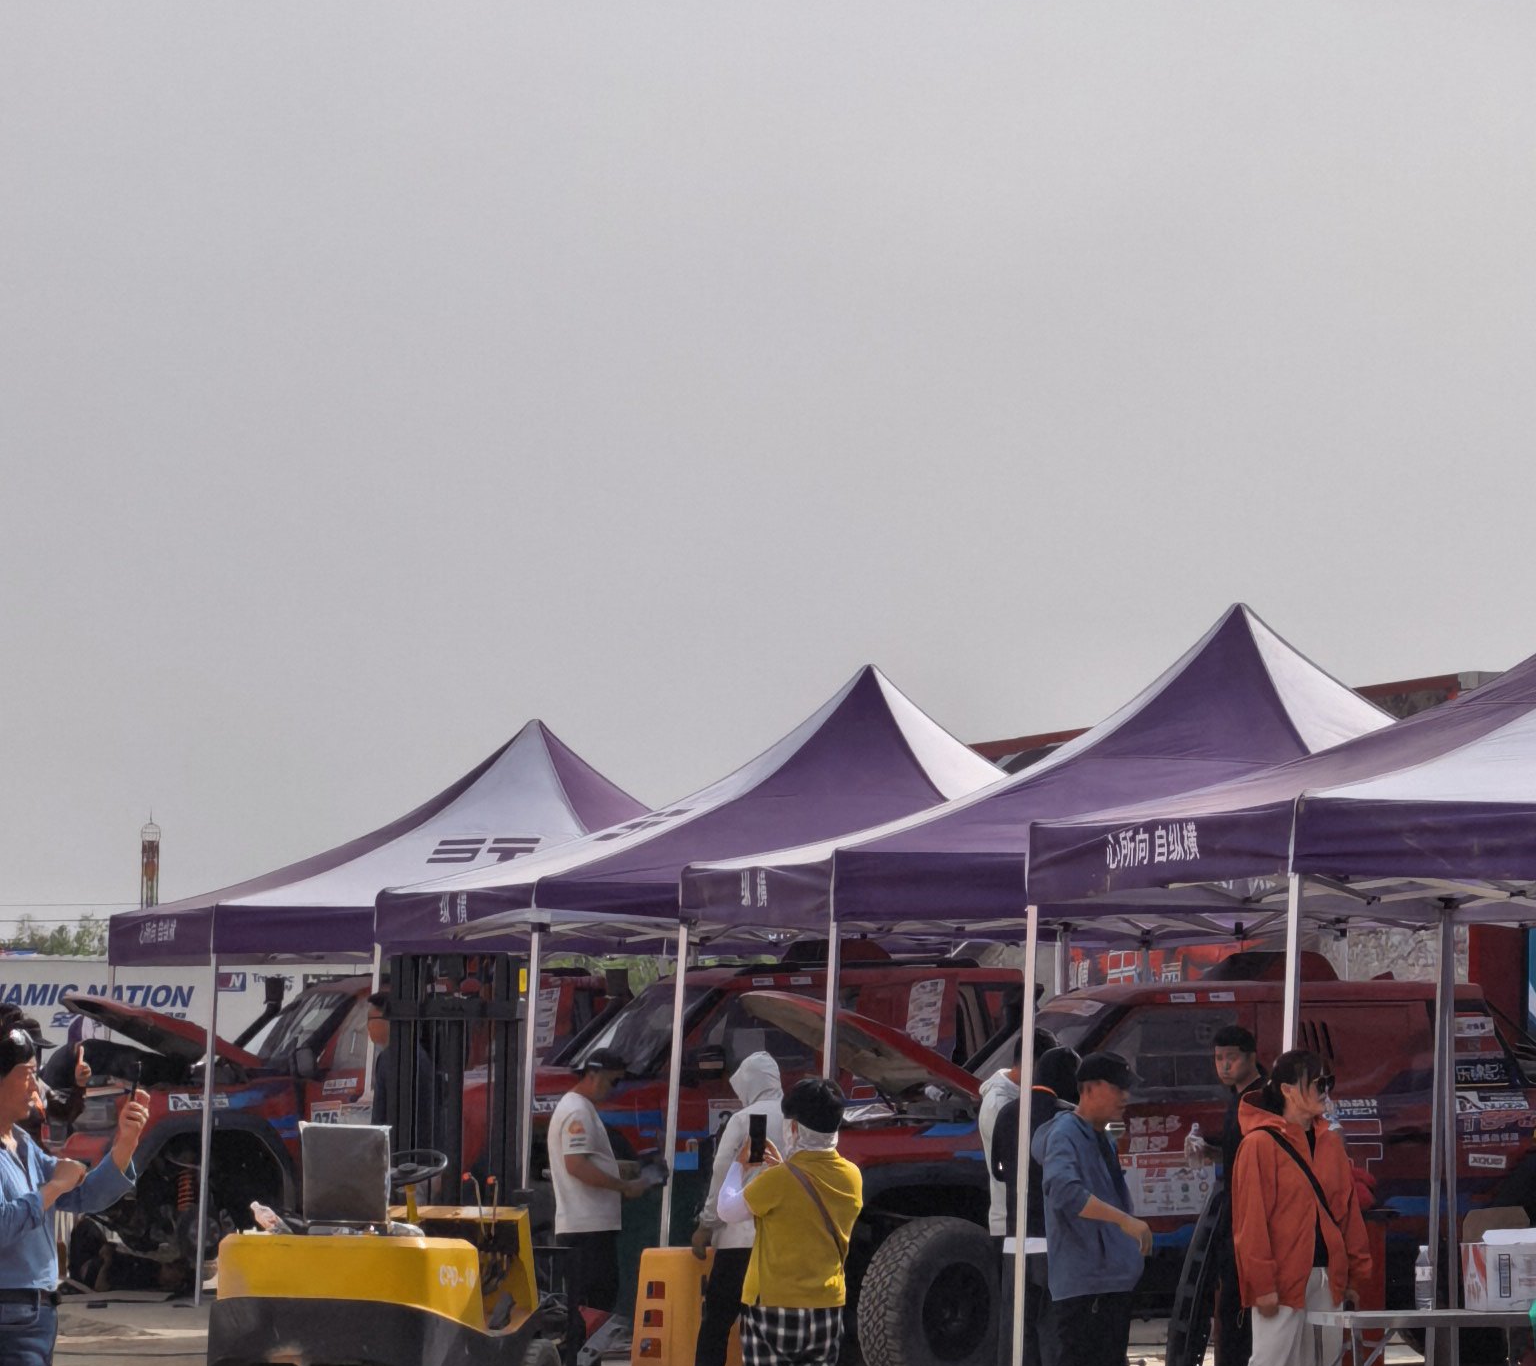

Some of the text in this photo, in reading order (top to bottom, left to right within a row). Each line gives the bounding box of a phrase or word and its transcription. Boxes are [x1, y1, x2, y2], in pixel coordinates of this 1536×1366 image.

[1106, 822, 1200, 869] 心所向 自纵横
